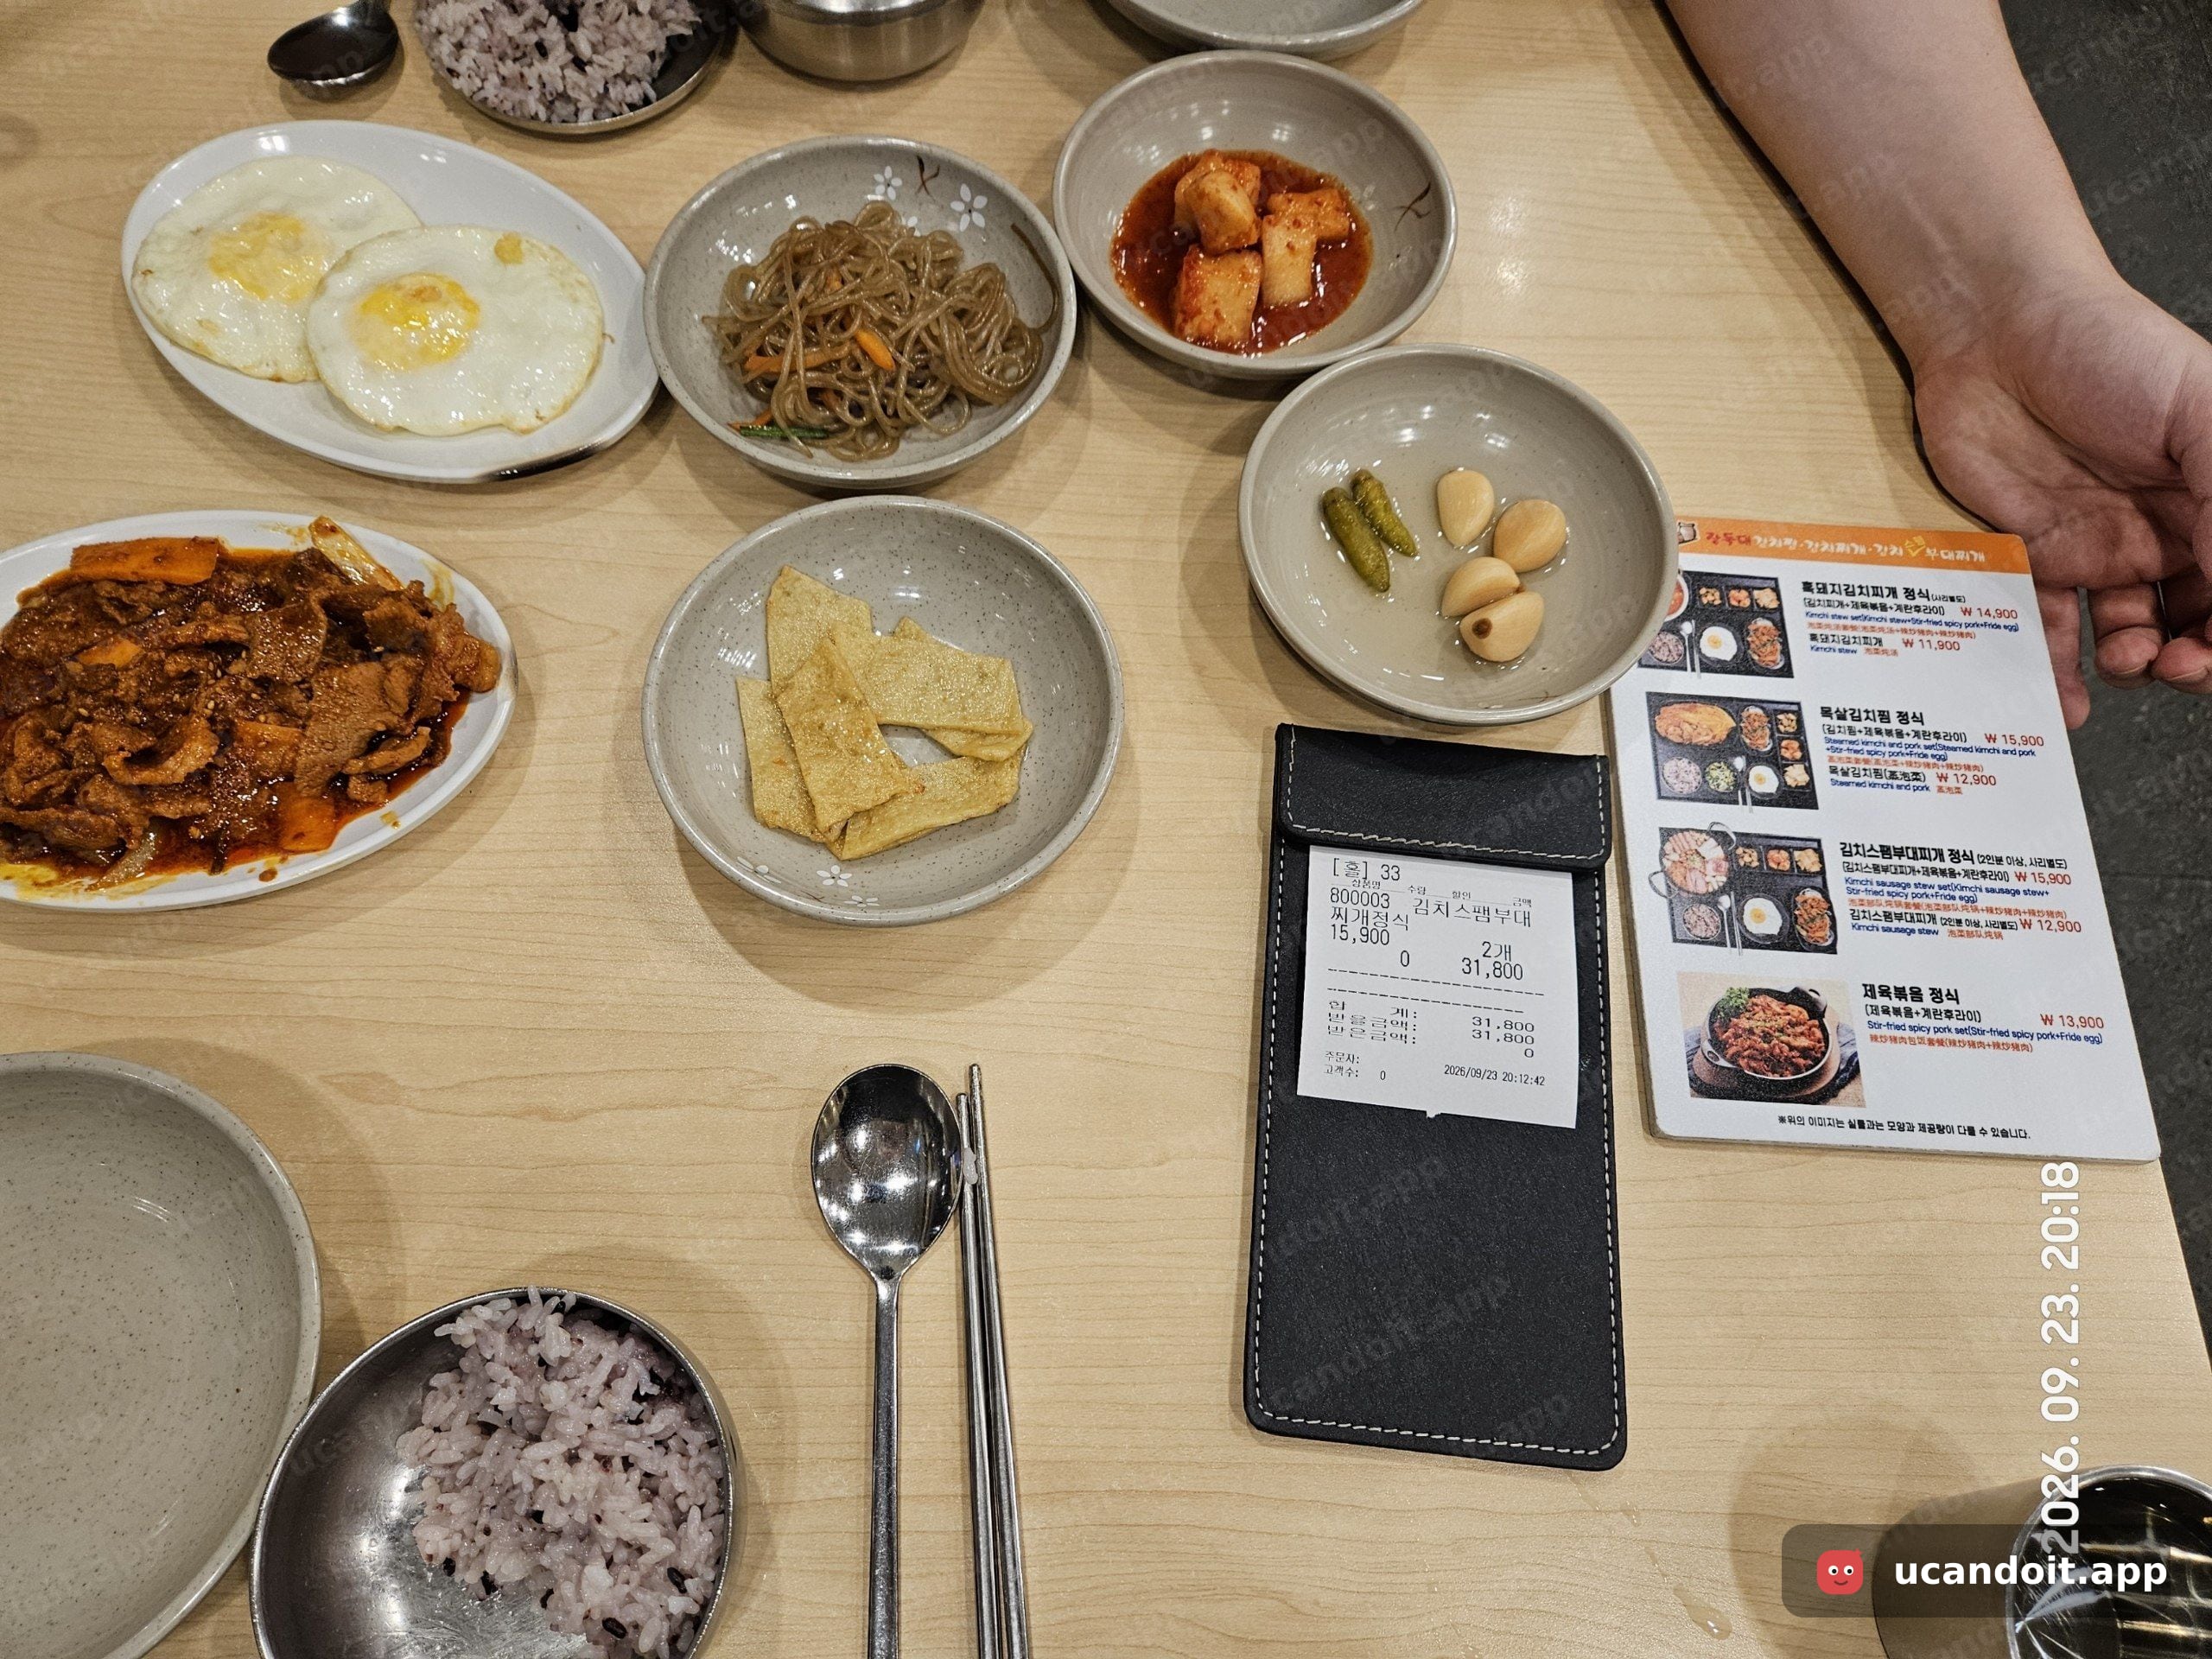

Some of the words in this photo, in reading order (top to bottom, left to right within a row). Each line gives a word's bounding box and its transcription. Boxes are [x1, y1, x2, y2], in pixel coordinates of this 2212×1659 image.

[1802, 581, 1898, 600] 흑돼지김치찌개
[1904, 587, 1931, 601] 정식
[1805, 611, 1829, 620] Kimchi
[1944, 619, 1963, 629] spicy
[1978, 607, 2018, 620] 14,900
[1809, 632, 1884, 647] 흑돼지김치찌개
[1919, 639, 1961, 652] 11,900
[1810, 645, 1837, 653] Kimchi
[1838, 646, 1858, 655] stew
[1820, 706, 1891, 724] 목살김치찜
[1896, 711, 1924, 726] 정식
[1824, 736, 1859, 746] Steamed
[1861, 738, 1887, 747] kimchi
[1888, 741, 1902, 749] and
[1904, 741, 1922, 751] pork
[1974, 745, 2000, 754] kimchi
[2002, 747, 2017, 756] and
[2018, 749, 2037, 758] pork
[2002, 734, 2044, 747] 15,900
[1866, 749, 1886, 759] spicy
[1830, 778, 1866, 788] Steamed
[1868, 779, 1894, 790] kimchi
[1896, 782, 1910, 791] and
[1912, 784, 1930, 793] pork
[1954, 772, 1997, 786] 12,900
[1839, 841, 1944, 863] 김치스팸부대찌개
[1948, 849, 1976, 865] 정식
[1977, 853, 2005, 866] (2인분
[2006, 855, 2027, 868] 이상,
[2030, 857, 2068, 869] 사리별도)
[1381, 864, 1401, 880] 33
[2031, 873, 2071, 886] 15,900
[1351, 879, 1381, 889] 상품명
[1452, 891, 1471, 899] 할인
[1513, 897, 1532, 907] 금액
[1845, 877, 1873, 887] Kimchi
[1875, 879, 1911, 890] sausage
[1913, 881, 1936, 891] stew
[1985, 886, 2021, 897] sausage
[2023, 888, 2050, 897] stew+
[1846, 887, 1885, 897] Stir-fried
[1886, 889, 1909, 900] spicy
[1958, 893, 1978, 904] egg)
[1331, 887, 1389, 909] 800003
[1413, 898, 1531, 927] 김치스팸부대
[1331, 906, 1408, 931] 찌개정식
[1849, 908, 1937, 925] 김치스팸부대찌개
[1941, 916, 1963, 928] (2인분
[1965, 918, 1984, 929] 이상,
[1986, 918, 2018, 931] 사리별도)
[2037, 919, 2082, 933] 12,900
[1331, 924, 1389, 945] 15,900
[1852, 923, 1879, 932] Kimchi
[1881, 925, 1916, 936] sausage
[1917, 927, 1939, 936] stew
[1482, 941, 1511, 962] 2개
[1400, 950, 1410, 967] 0
[1462, 957, 1523, 981] 31,800
[1862, 983, 1924, 1003] 제육볶음
[1929, 986, 1961, 1005] 정식
[1472, 1016, 1535, 1032] 31,800
[2058, 1014, 2105, 1029] 13,900
[1472, 1029, 1535, 1045] 31,800
[1867, 1020, 1906, 1032] Stir-fried
[1908, 1023, 1931, 1034] spicy
[1934, 1025, 1953, 1035] pork
[2012, 1028, 2034, 1040] spicy
[2083, 1033, 2103, 1045] egg)
[1524, 1048, 1535, 1058] 0
[1380, 1070, 1386, 1080] 0
[1444, 1065, 1497, 1081] 2026/09/23
[1503, 1071, 1546, 1086] 20:12:42
[1808, 1116, 1845, 1128] 이미지는
[1847, 1119, 1885, 1131] 실물과는
[1887, 1121, 1916, 1133] 모양과
[1917, 1122, 1955, 1135] 제공량이
[1957, 1125, 1976, 1136] 다를
[1979, 1126, 1988, 1136] 수
[1990, 1127, 2031, 1140] 있습니다.
